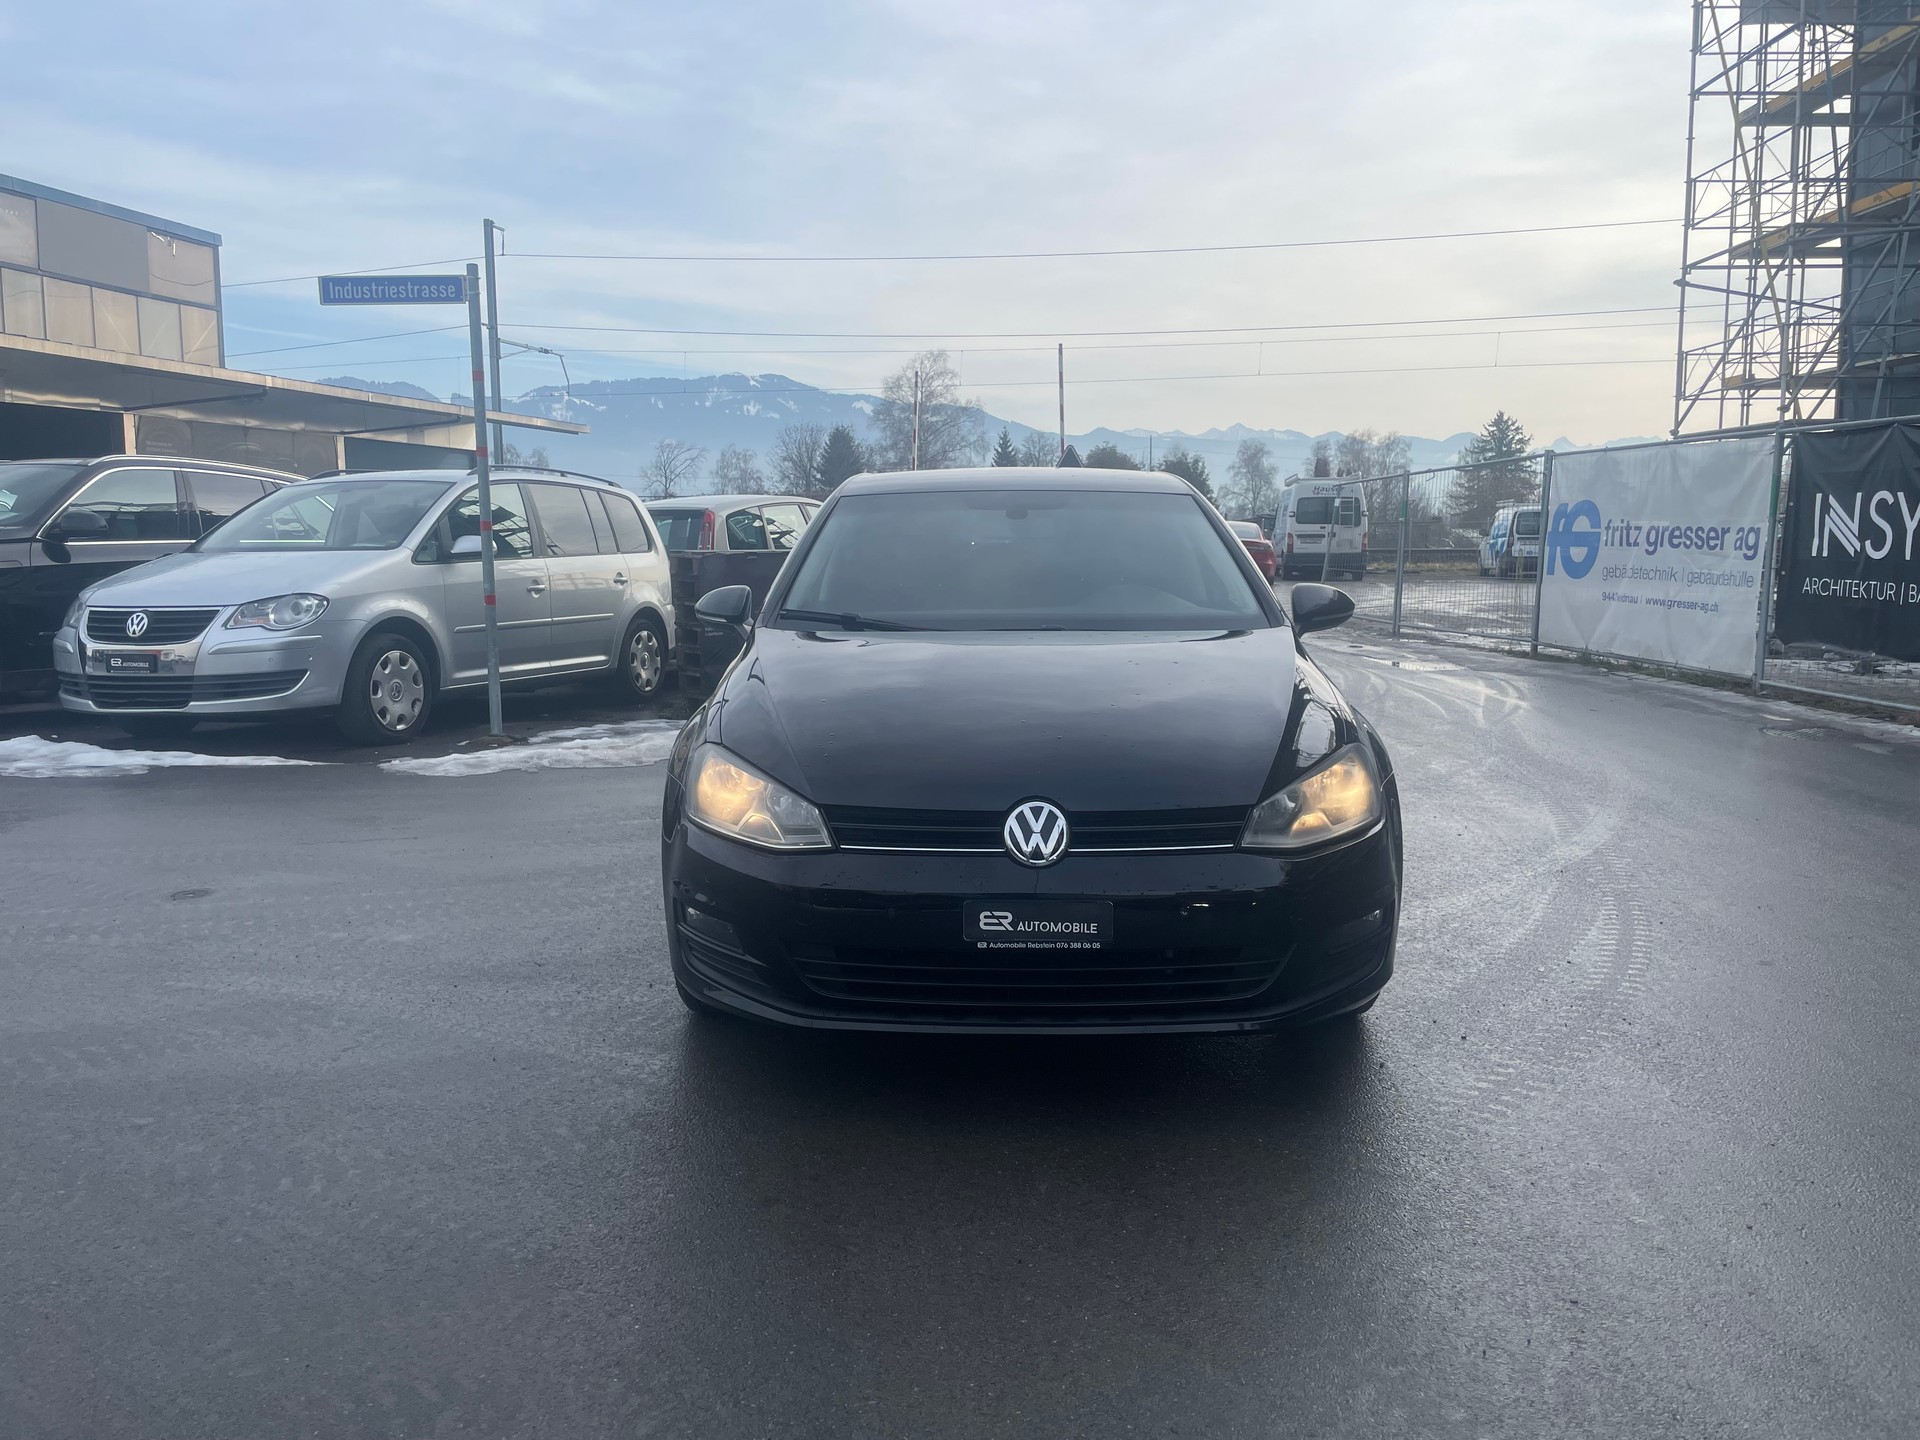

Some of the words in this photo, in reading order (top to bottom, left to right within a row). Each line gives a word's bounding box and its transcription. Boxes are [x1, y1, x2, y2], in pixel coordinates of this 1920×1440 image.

[329, 281, 456, 299] Industriestrasse
[1604, 519, 1643, 547] fritz
[1644, 523, 1731, 556] gresser
[1734, 526, 1761, 561] ag
[1602, 564, 1679, 582] gebädetechnik
[1686, 570, 1754, 588] gebäudehülle
[1802, 577, 1896, 601] ARCHITEKTUR
[1908, 583, 1920, 603] B
[1645, 597, 1719, 614] www.gresser-ag.ch
[1004, 802, 1066, 866] VW
[979, 911, 1014, 931] ER
[1017, 921, 1098, 934] AUTOMOBILE
[989, 941, 1026, 949] Automobile
[1028, 941, 1055, 949] Rebstein
